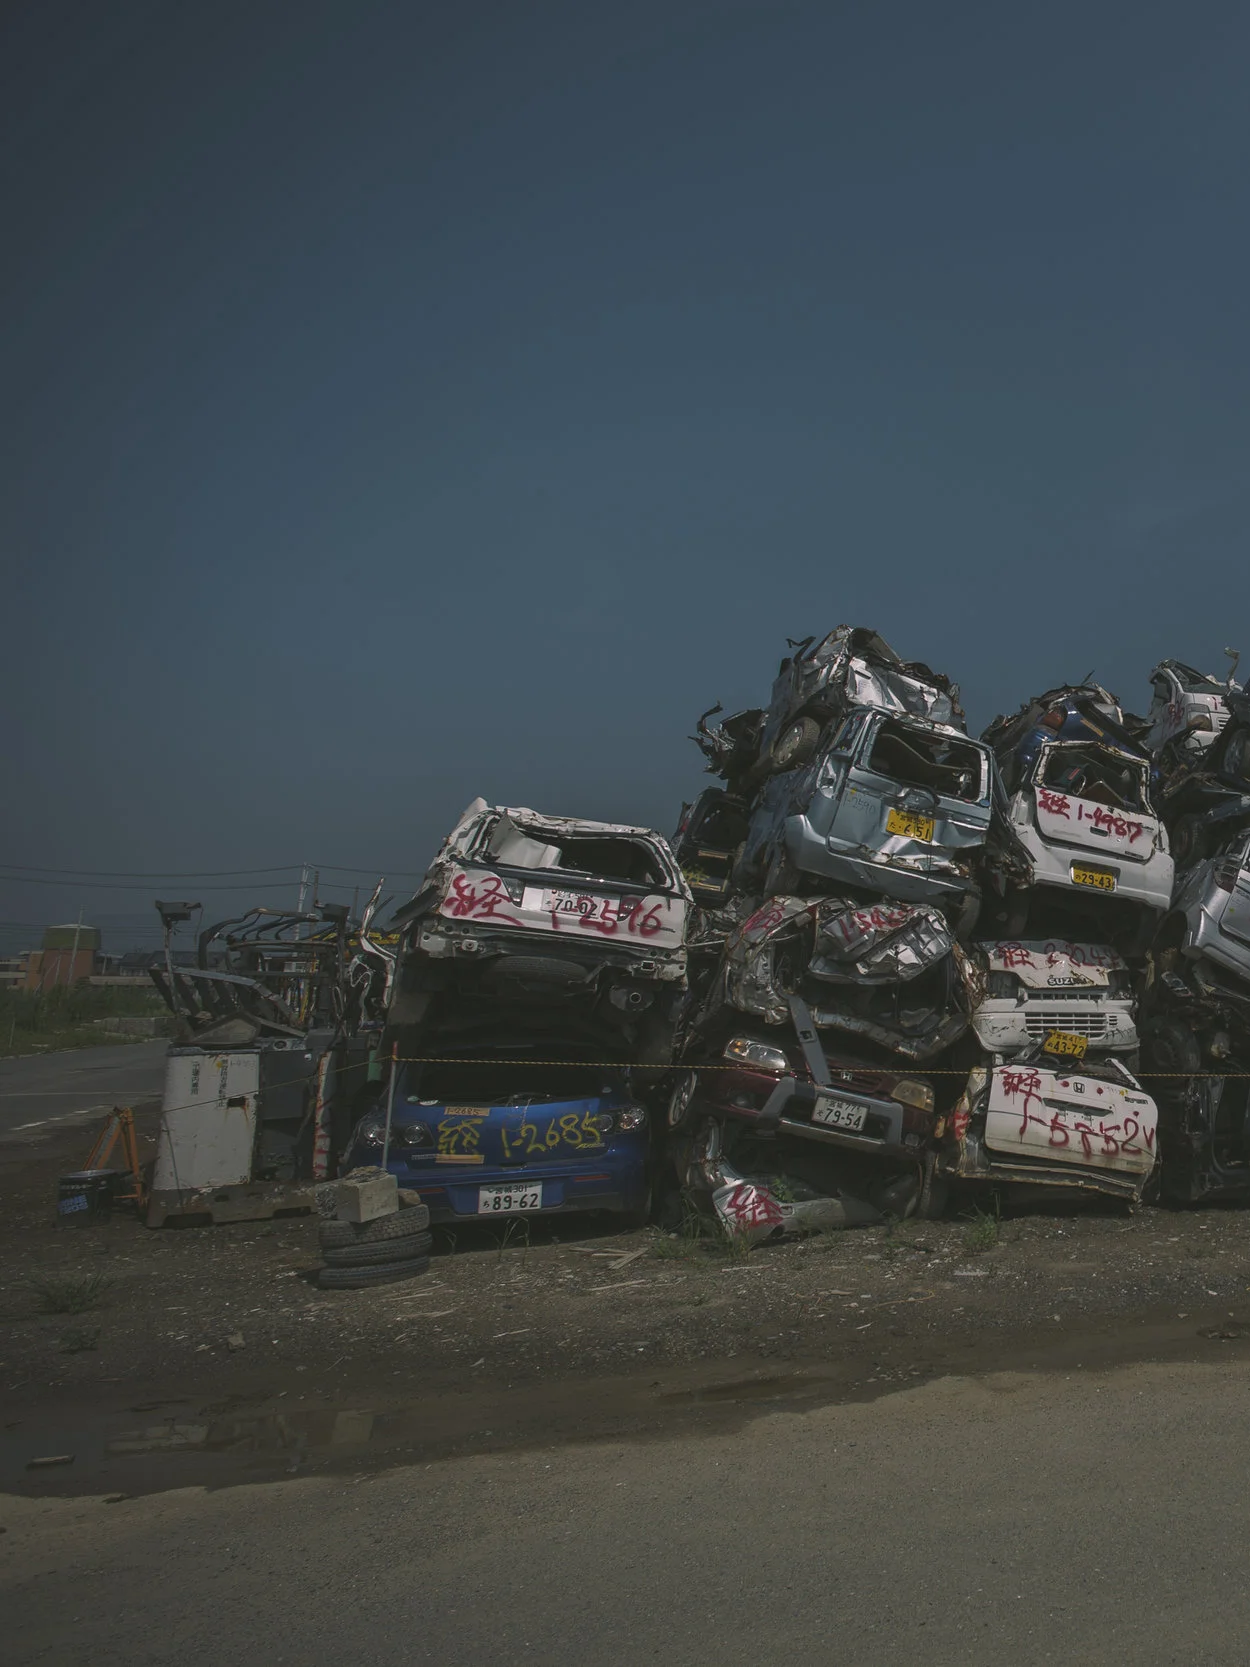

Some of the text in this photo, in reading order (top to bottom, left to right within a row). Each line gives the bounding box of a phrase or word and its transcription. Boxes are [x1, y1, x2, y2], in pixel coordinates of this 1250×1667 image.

[1077, 803, 1143, 844] 1-4987
[1082, 873, 1112, 888] 29-43
[554, 898, 599, 916] 70-02
[1053, 1040, 1085, 1057] 43-72
[446, 1107, 480, 1117] 1-2685
[823, 1107, 863, 1129] 79-54
[501, 1110, 603, 1159] 1-2685
[493, 1193, 539, 1211] 89-62
